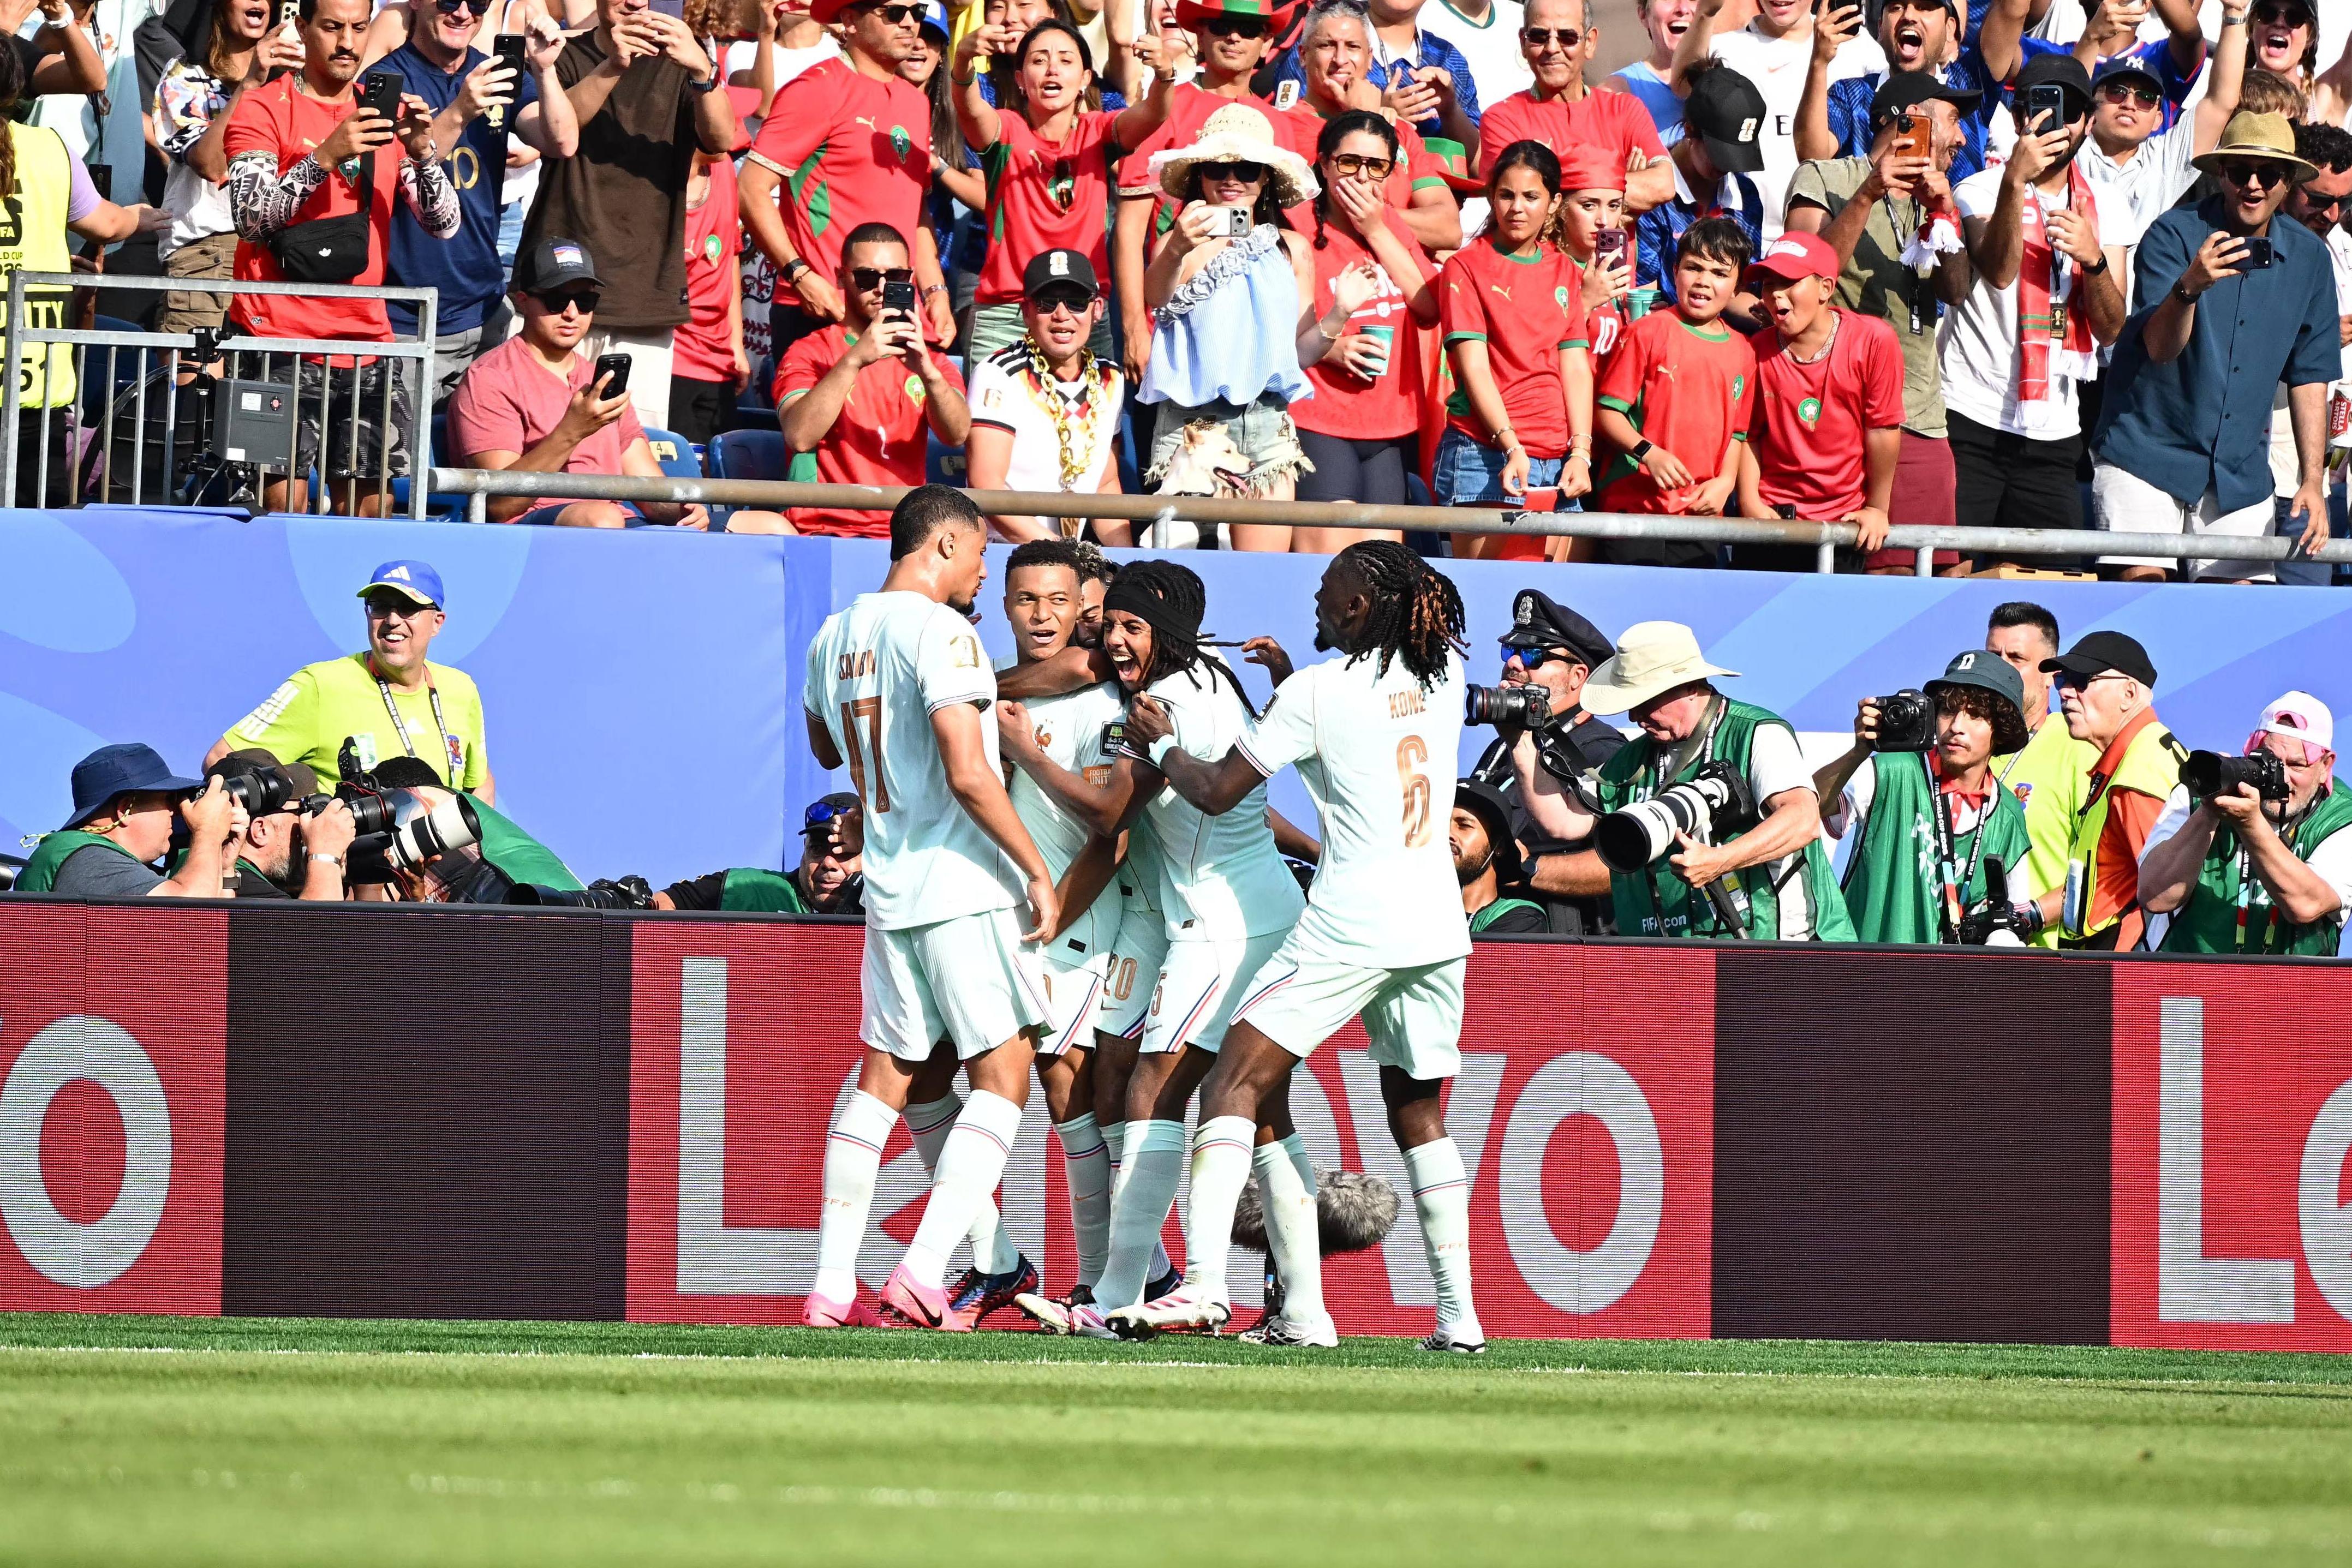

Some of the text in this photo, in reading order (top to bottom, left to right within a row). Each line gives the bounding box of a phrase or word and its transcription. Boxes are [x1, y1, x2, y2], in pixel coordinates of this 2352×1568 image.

[1592, 316, 1618, 355] 10
[2331, 400, 2341, 430] ARTOIS
[2337, 401, 2347, 430] STELLA
[656, 442, 663, 452] 4
[379, 680, 389, 695] FIFA
[384, 693, 397, 716] WORLD
[392, 715, 403, 729] CUP
[840, 696, 891, 813] 17
[1089, 768, 1111, 776] FOOTBA
[1089, 775, 1111, 785] UNIT
[1396, 735, 1432, 847] 6
[1935, 795, 1944, 819] WORLD
[1971, 837, 1982, 862] WORLD
[1968, 861, 1976, 875] FIFA
